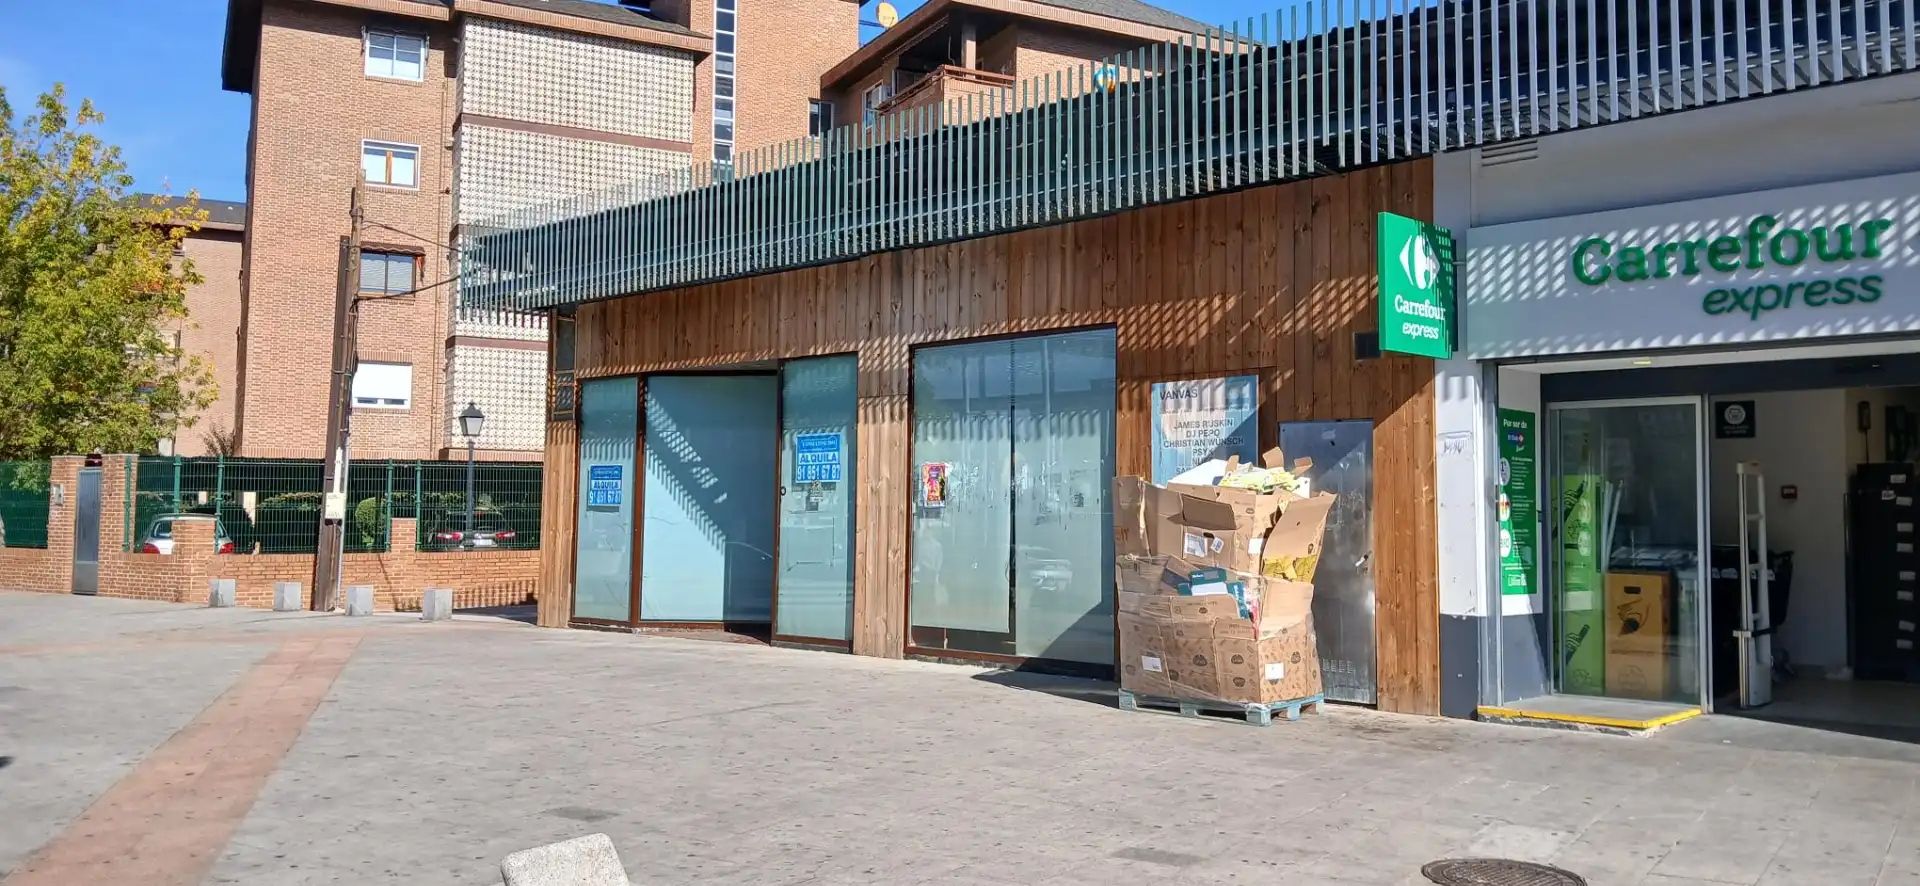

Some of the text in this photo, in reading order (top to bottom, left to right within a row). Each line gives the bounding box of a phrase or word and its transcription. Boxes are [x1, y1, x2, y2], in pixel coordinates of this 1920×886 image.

[1572, 214, 1893, 286] Carrefour
[1702, 275, 1883, 321] express
[1394, 294, 1446, 321] Carrefour
[1402, 321, 1439, 340] express
[1160, 386, 1198, 400] VANVAS
[1174, 418, 1233, 430] JAMES RUSKIN
[1186, 429, 1220, 438] DJ PEPO
[1163, 439, 1206, 448] CHRISTIAN
[800, 452, 838, 463] ALQUILA
[797, 465, 806, 480] 91
[821, 464, 831, 480] 67
[593, 481, 619, 489] ALQUILA
